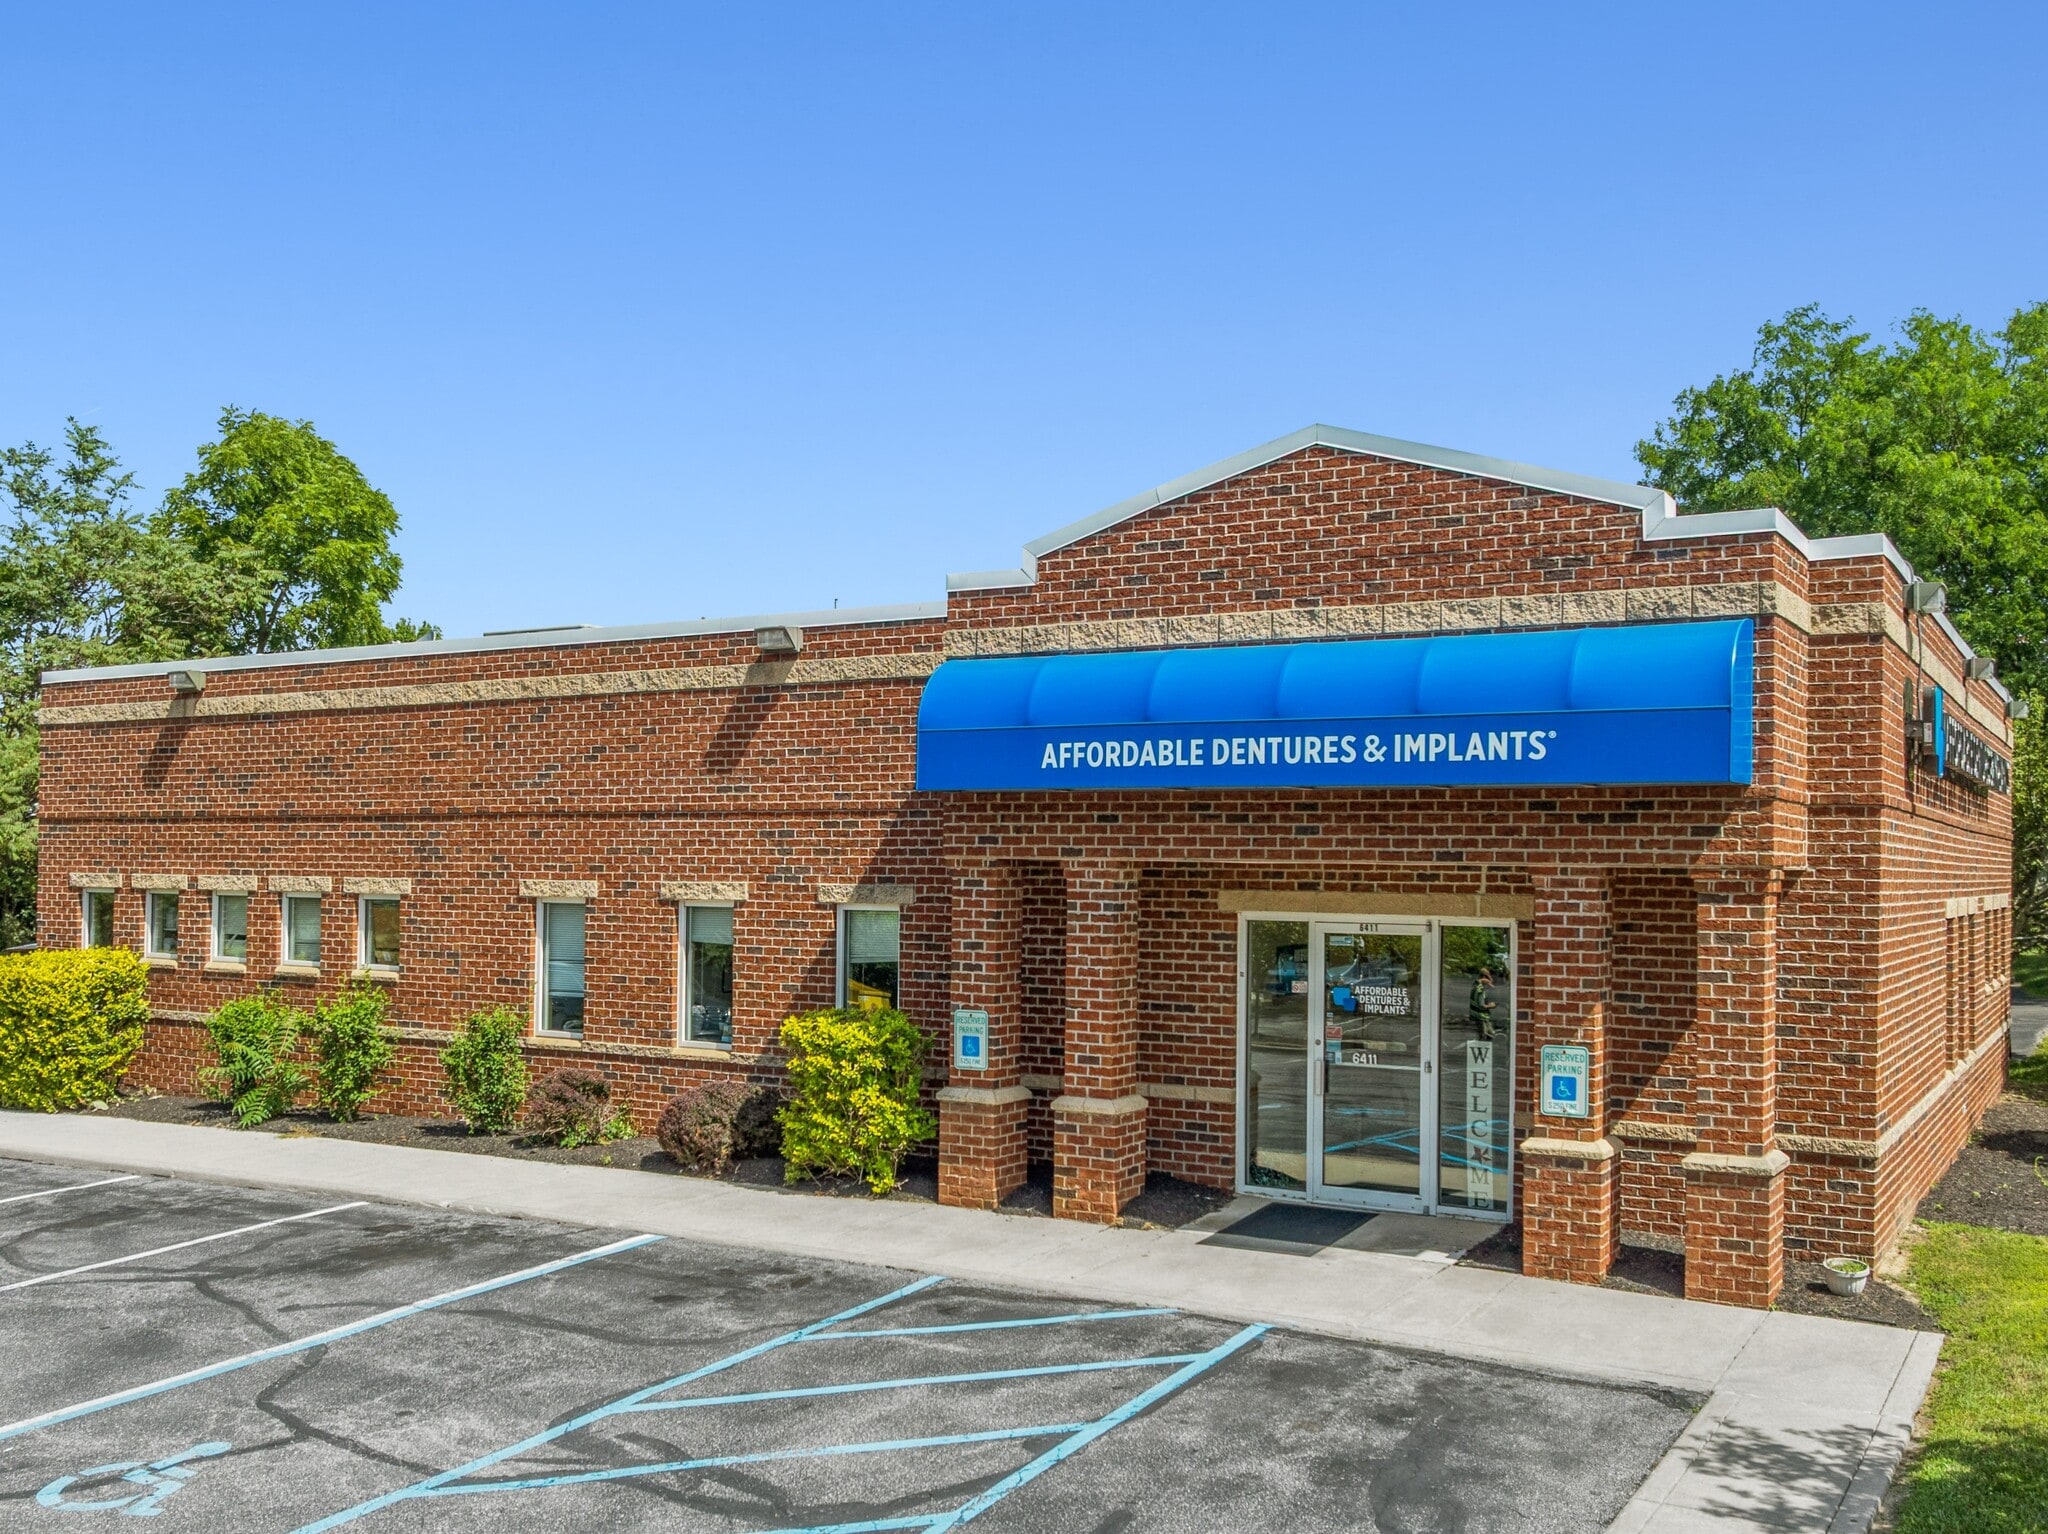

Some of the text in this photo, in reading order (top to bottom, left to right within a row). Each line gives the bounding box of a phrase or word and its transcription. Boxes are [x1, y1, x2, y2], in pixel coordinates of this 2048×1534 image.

[1041, 739, 1204, 769] AFFORDABLE
[1212, 735, 1357, 765] DENTURES
[1363, 734, 1388, 762] &
[1360, 924, 1379, 932] 6411
[1355, 986, 1408, 997] AFFORDABLE
[1360, 995, 1410, 1006] DENTURES &
[957, 1016, 985, 1025] RESERVED
[959, 1026, 984, 1035] PARKING
[1352, 1052, 1378, 1065] 6411
[1545, 1052, 1585, 1063] RESERVED
[1547, 1064, 1583, 1075] PARKING
